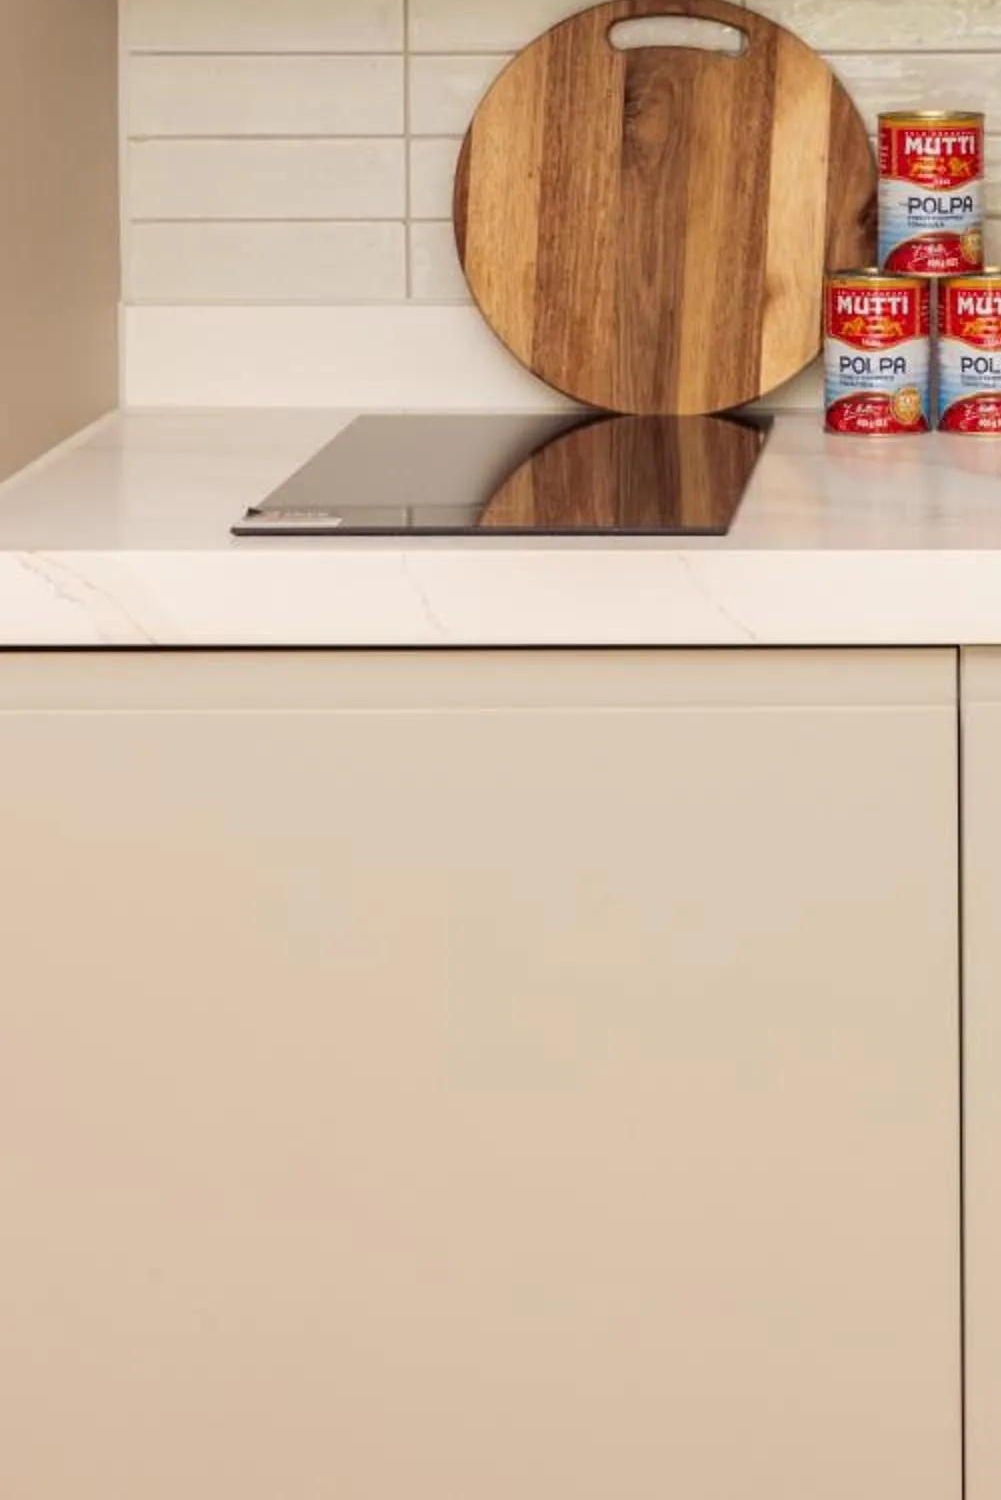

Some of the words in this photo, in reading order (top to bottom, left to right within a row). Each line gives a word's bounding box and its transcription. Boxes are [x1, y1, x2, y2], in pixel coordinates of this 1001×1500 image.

[904, 134, 976, 155] MUTTI
[908, 196, 973, 214] POLPA
[837, 295, 909, 315] MUTTI
